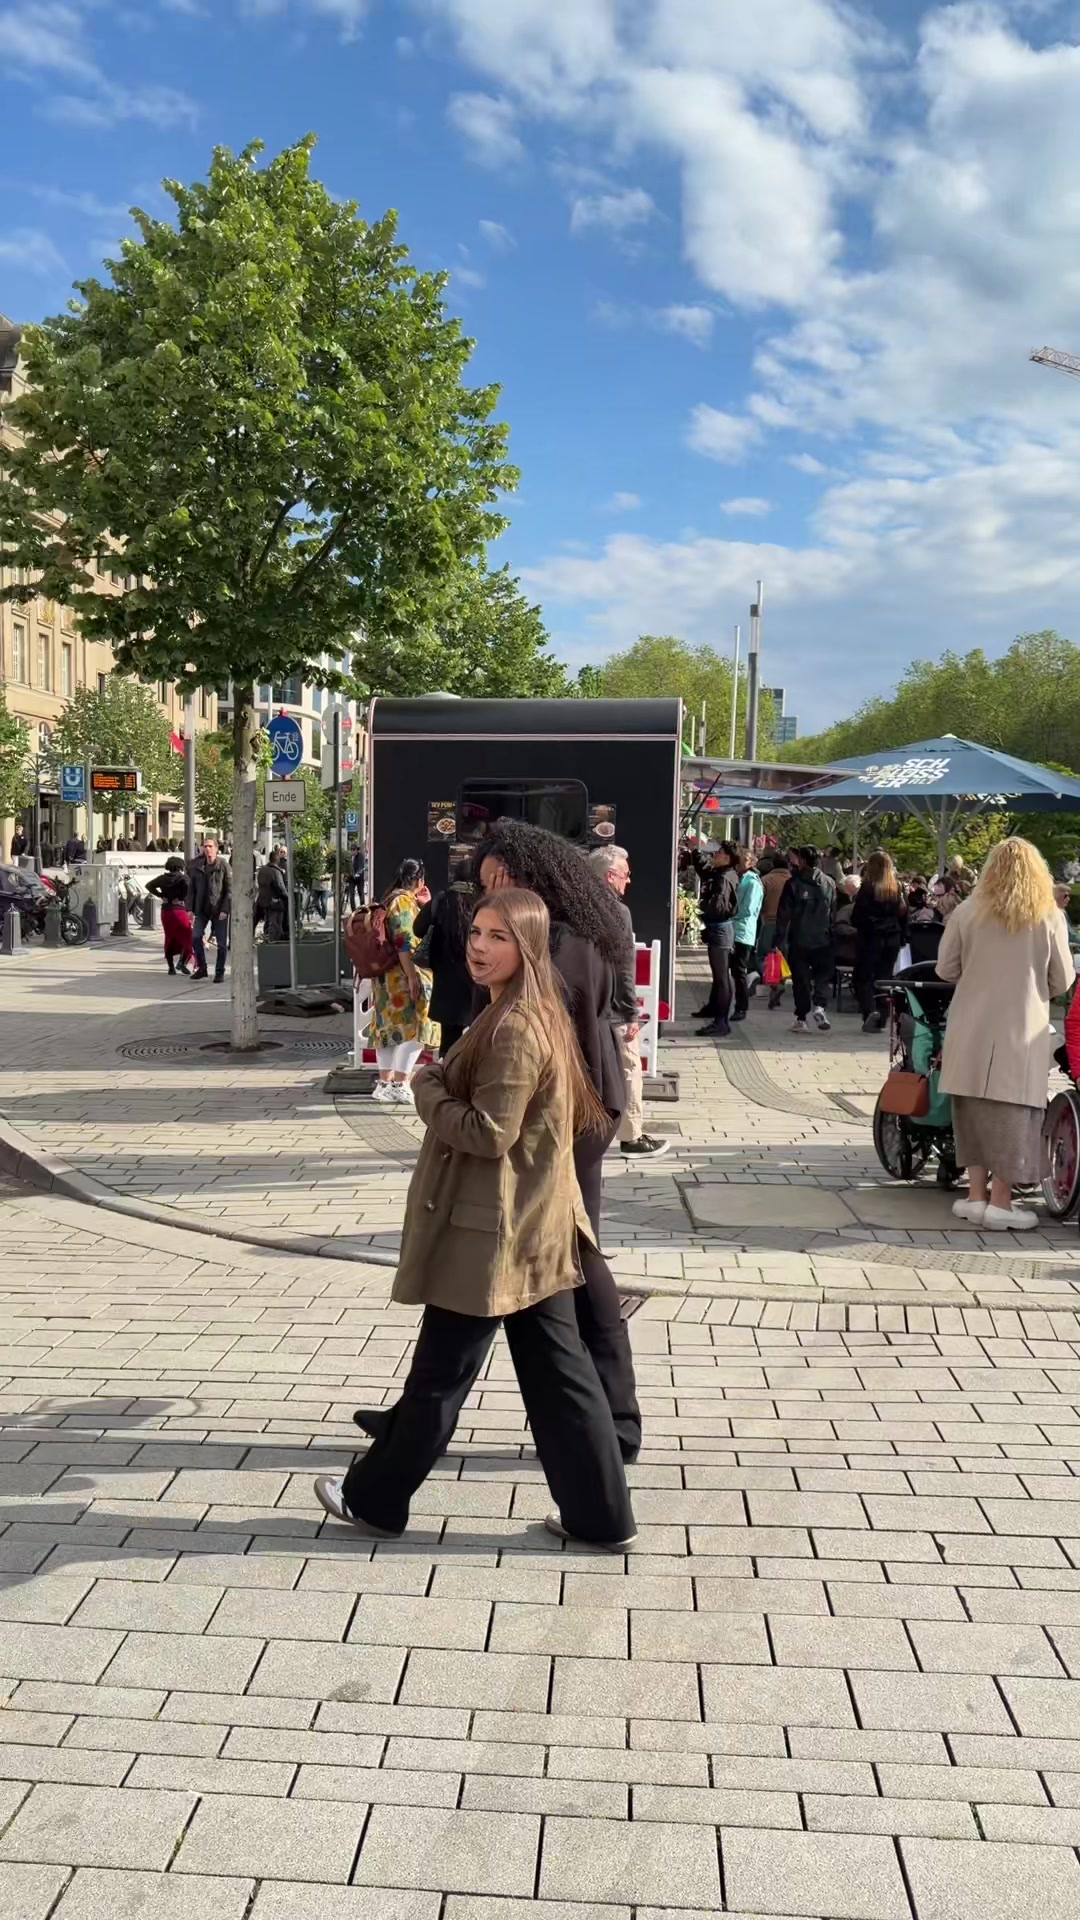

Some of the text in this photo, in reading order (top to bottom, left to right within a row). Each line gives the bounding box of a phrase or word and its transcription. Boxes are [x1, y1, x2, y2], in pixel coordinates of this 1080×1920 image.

[903, 758, 952, 769] SCH
[64, 767, 81, 786] U
[272, 791, 297, 802] Ende
[348, 812, 357, 824] U
